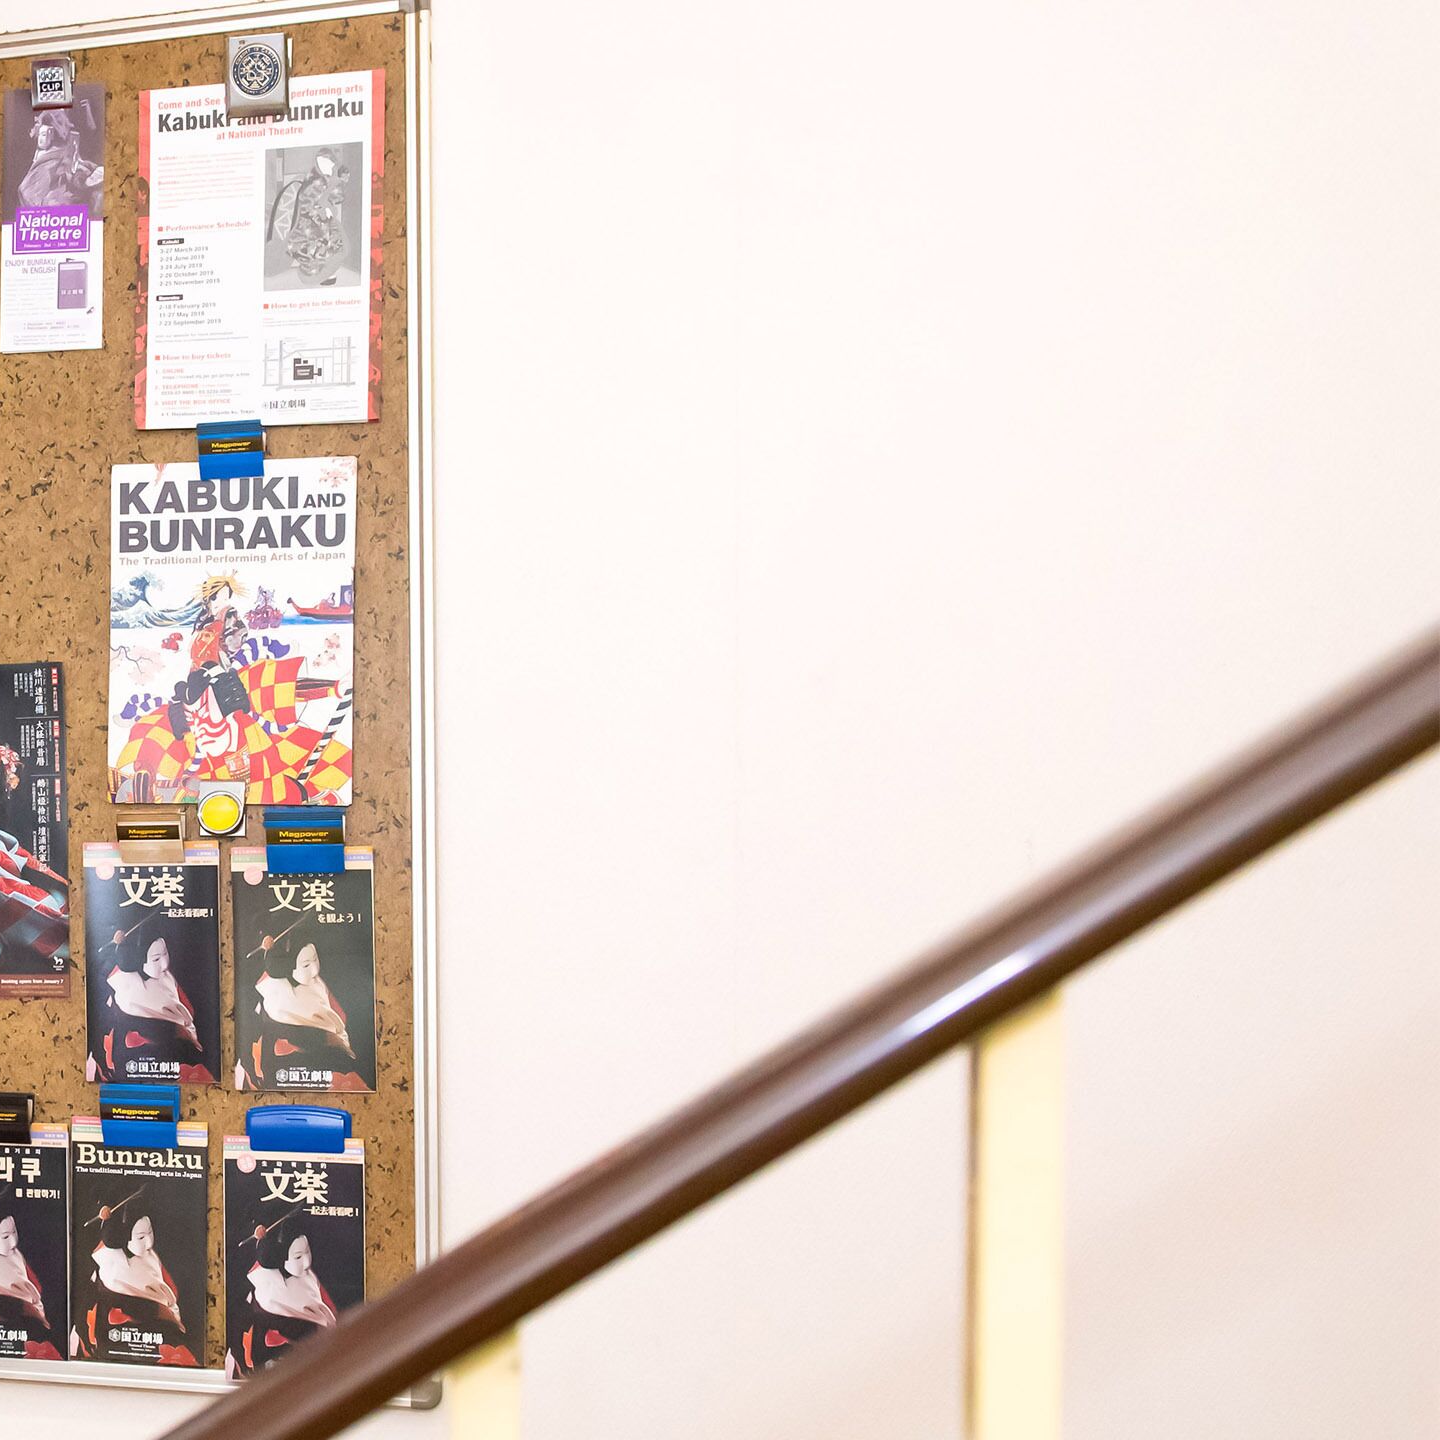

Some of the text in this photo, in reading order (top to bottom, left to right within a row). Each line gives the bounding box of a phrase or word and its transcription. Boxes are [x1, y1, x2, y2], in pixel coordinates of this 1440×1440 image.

[158, 84, 363, 110] Come and See performing arts
[217, 126, 303, 140] at National Theatre
[20, 213, 83, 227] National
[217, 220, 251, 228] Schedule
[19, 227, 82, 240] Theatre
[211, 440, 252, 448] Magpower
[120, 476, 346, 515] KABUKI AND
[119, 514, 346, 553] BUNRAKU
[120, 552, 345, 566] The Traditional Performing Arts of Japan
[119, 874, 184, 907] 文楽
[269, 879, 335, 912] 文楽
[138, 1062, 180, 1074] 国立劇場
[289, 1070, 333, 1082] 国立劇場
[77, 1144, 203, 1170] Bunraku
[124, 1169, 160, 1178] performing
[260, 1168, 328, 1204] 文楽
[121, 1331, 163, 1345] 国立劇場
